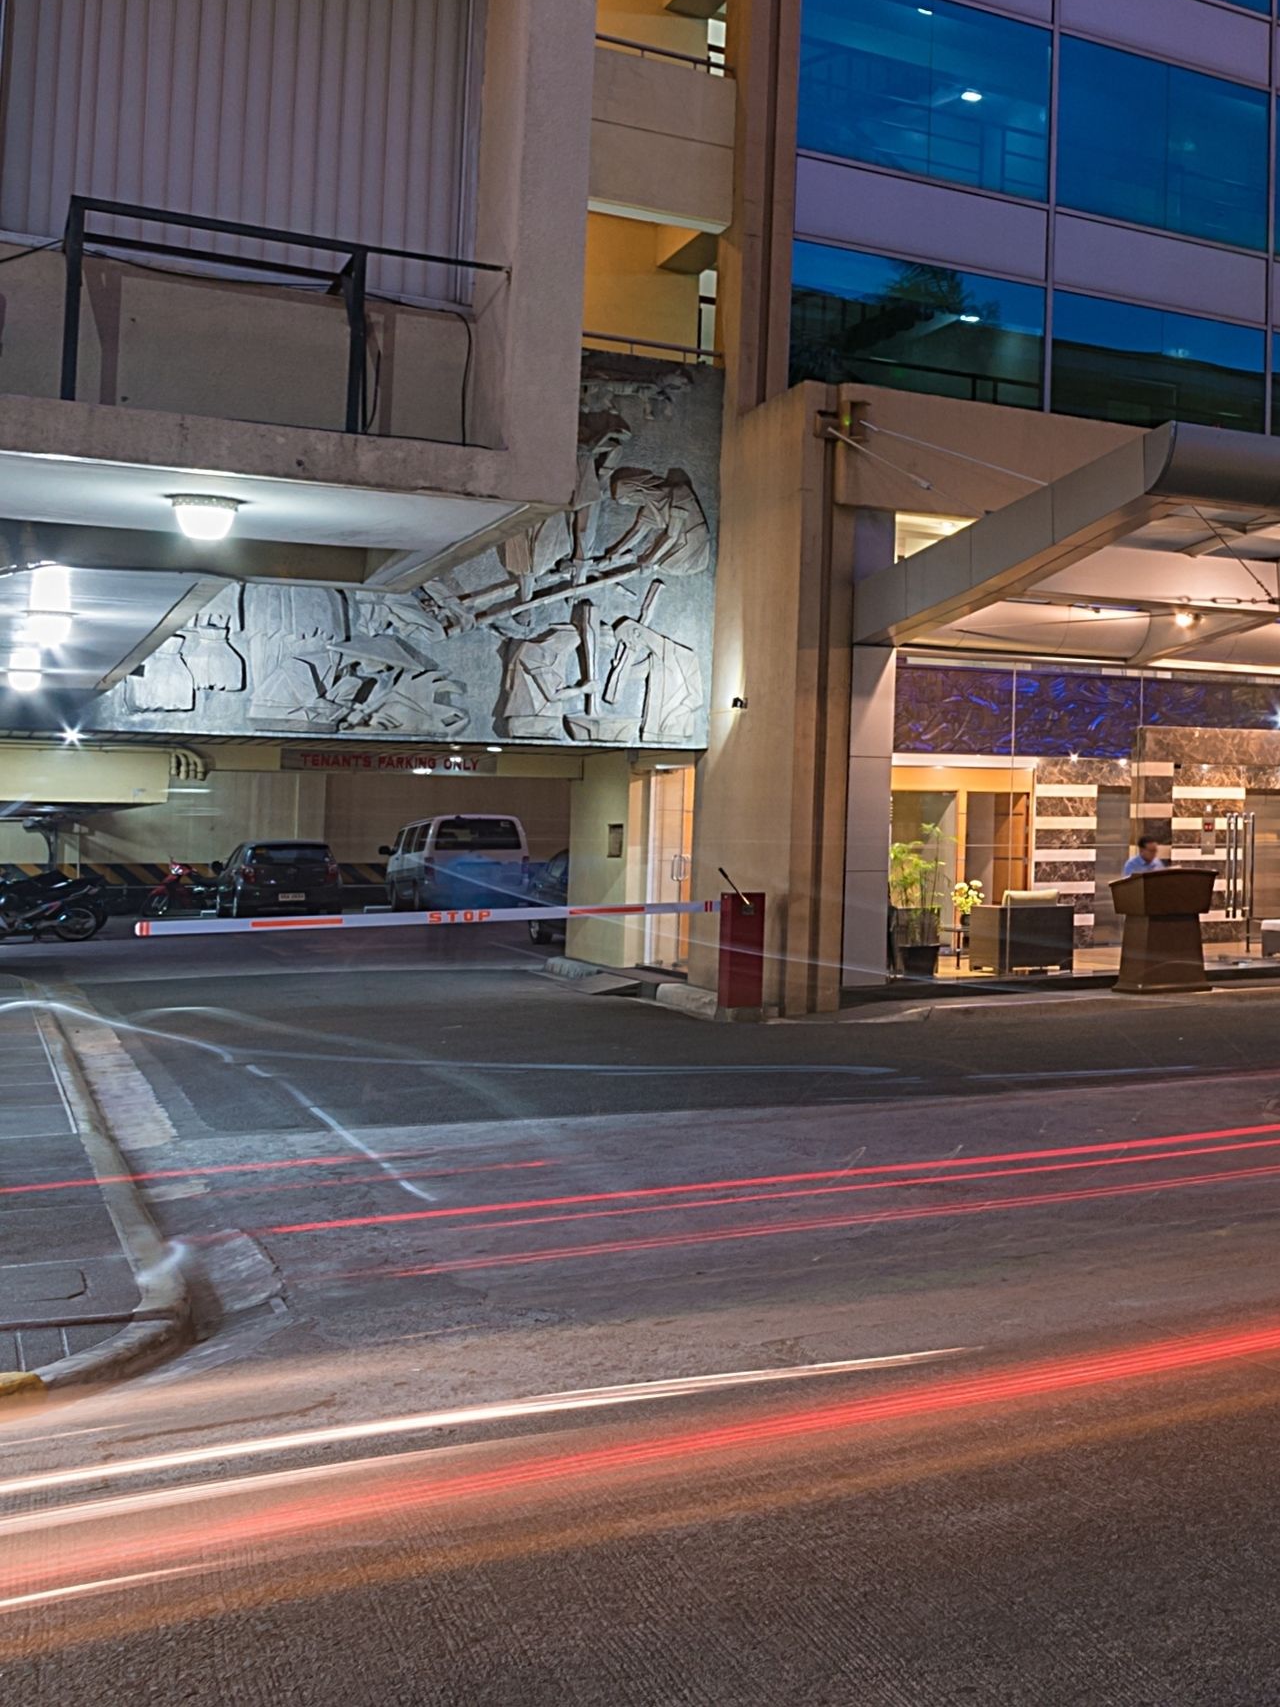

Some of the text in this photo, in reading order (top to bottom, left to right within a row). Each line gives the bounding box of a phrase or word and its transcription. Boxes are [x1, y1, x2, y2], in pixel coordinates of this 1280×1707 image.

[301, 753, 480, 770] TENANTS PARKING ONLY
[428, 910, 491, 924] STOP
